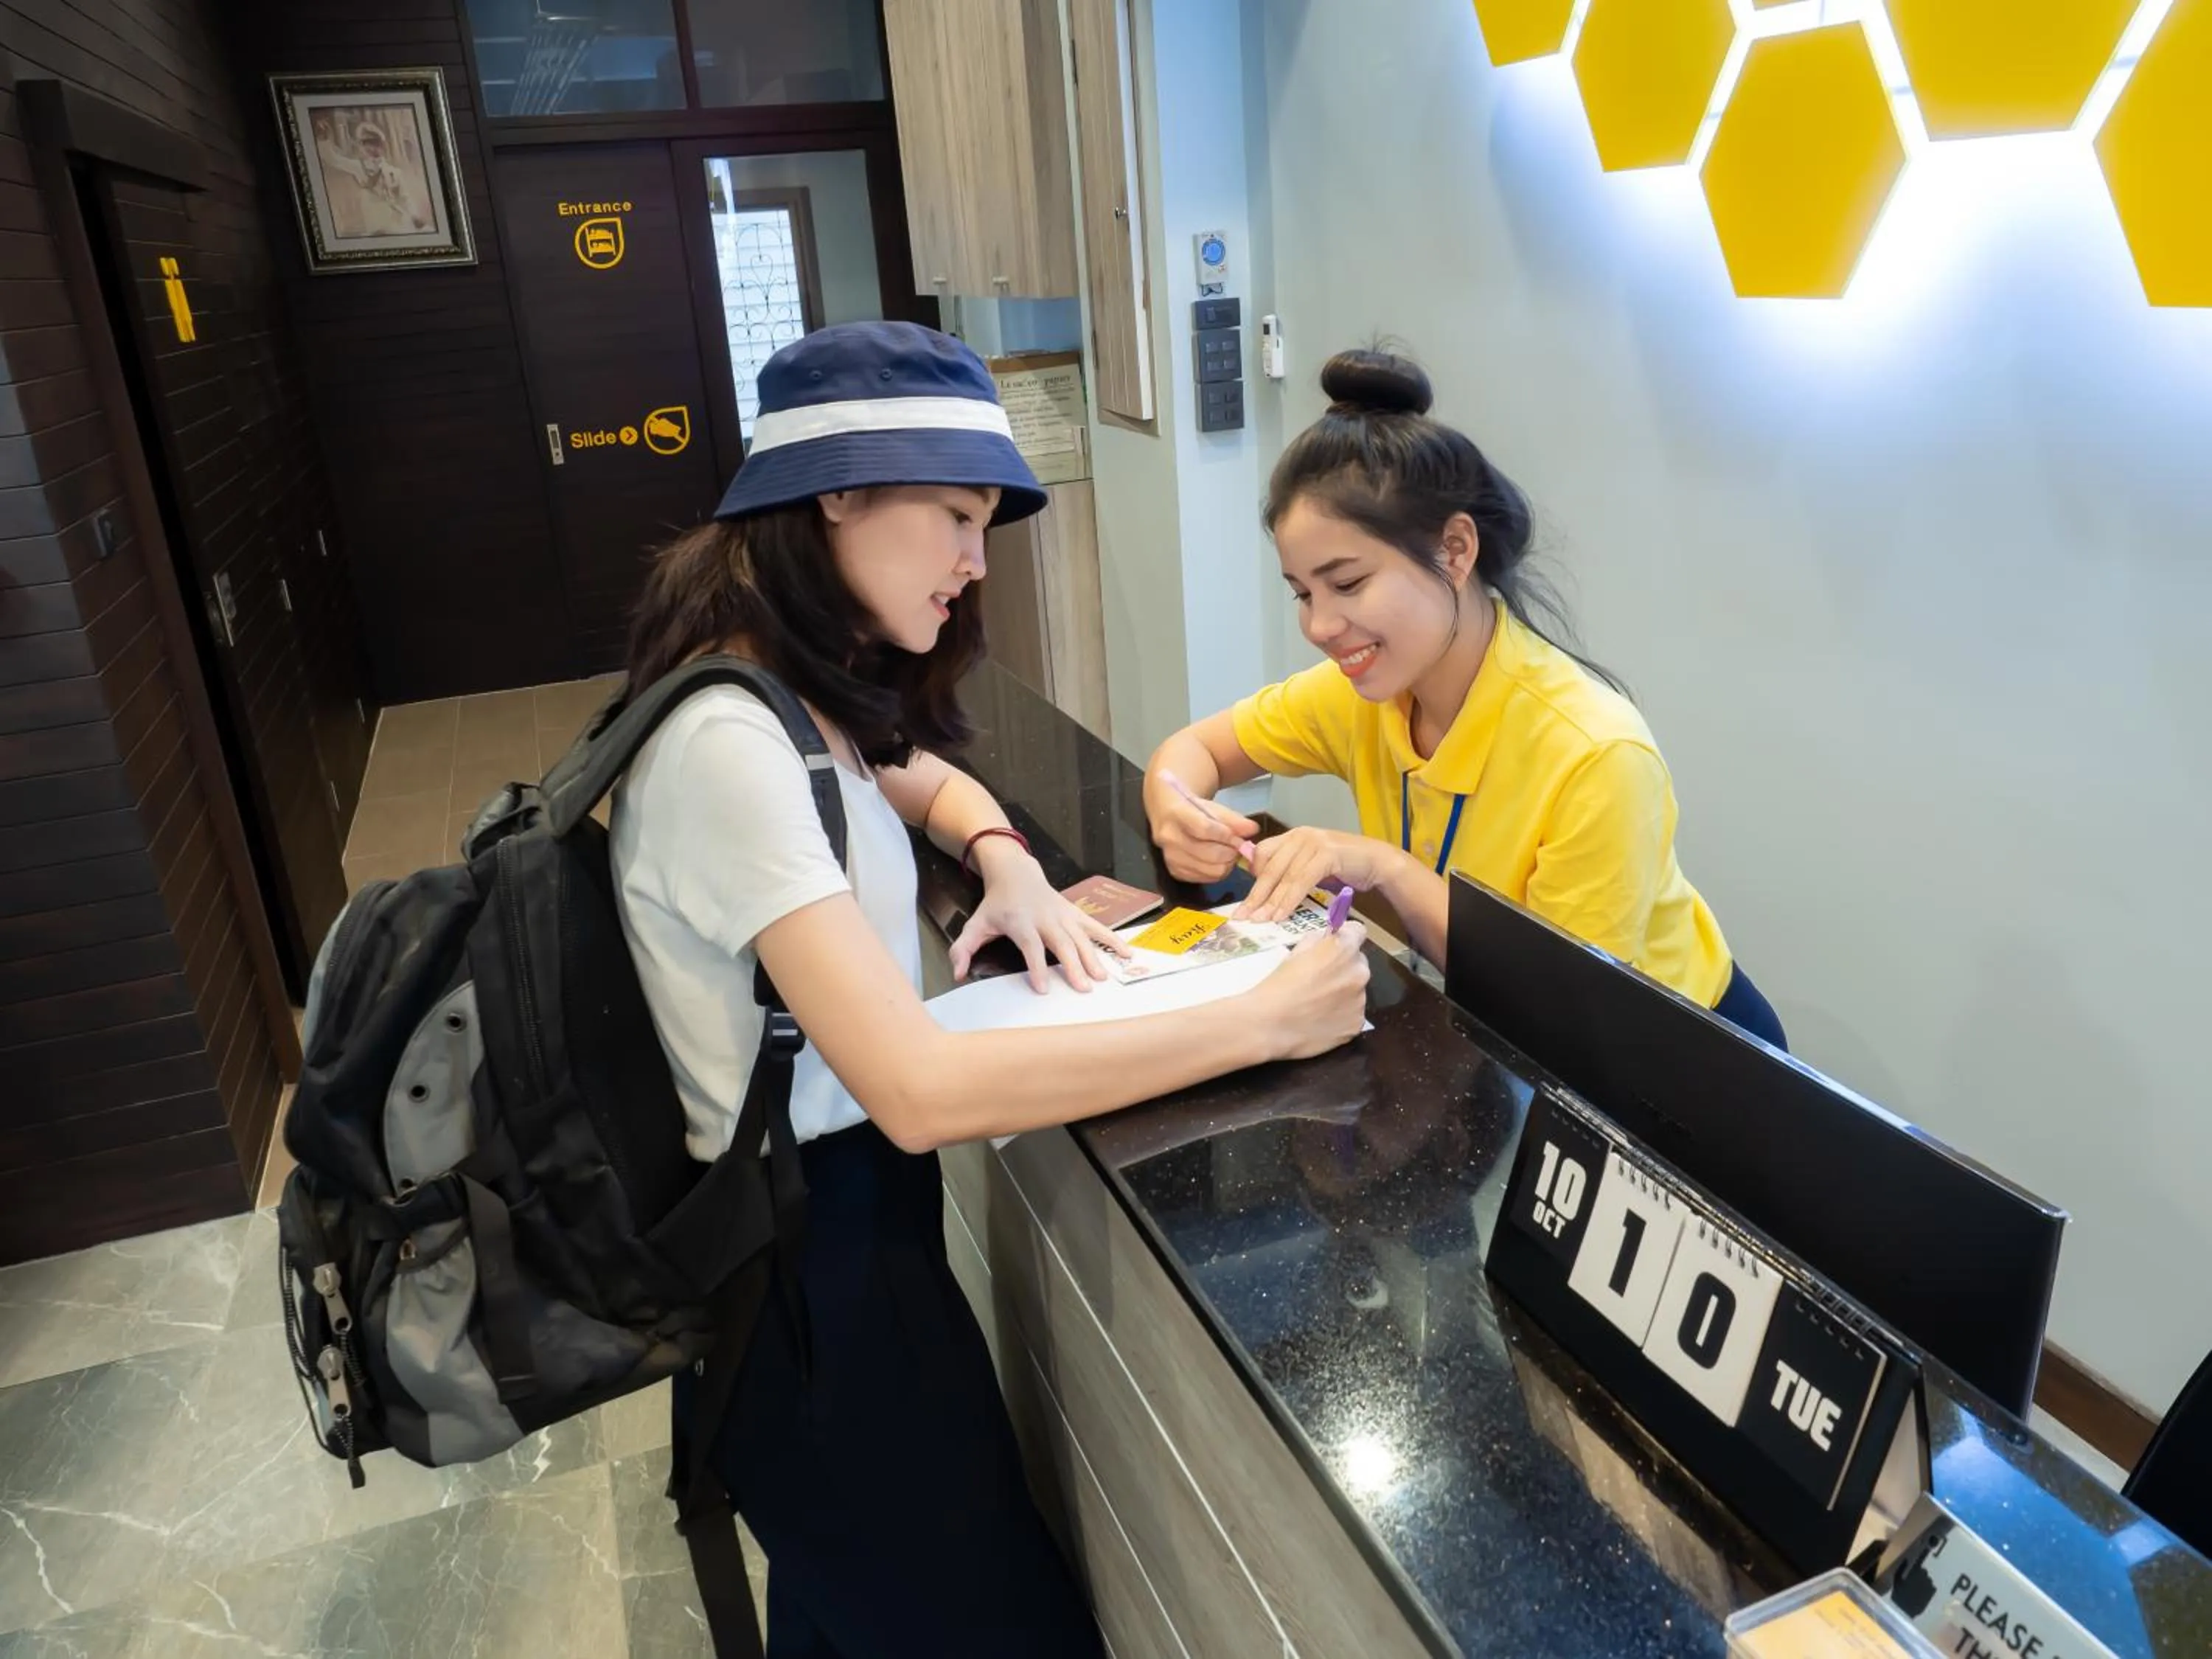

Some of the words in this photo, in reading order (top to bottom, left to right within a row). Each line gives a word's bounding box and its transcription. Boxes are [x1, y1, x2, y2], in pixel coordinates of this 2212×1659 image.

[558, 201, 632, 215] Entrance
[571, 430, 616, 448] Slide
[1535, 1141, 1586, 1220] 10
[1533, 1200, 1565, 1238] OCT
[1770, 1359, 1842, 1452] TUE
[1950, 1573, 2044, 1659] PLEASE
